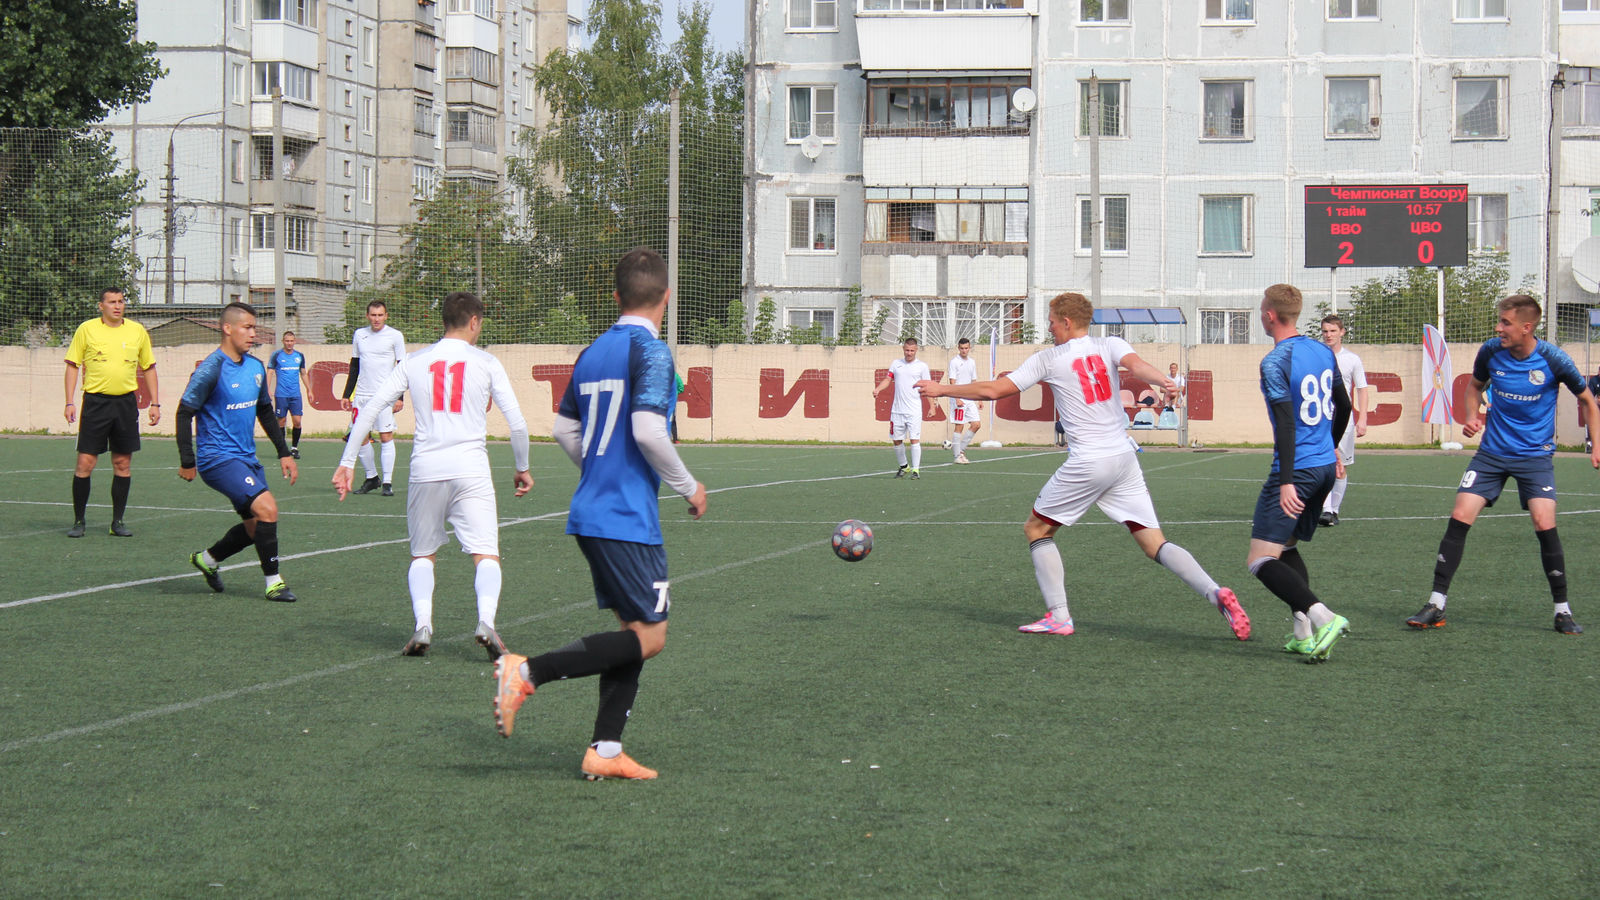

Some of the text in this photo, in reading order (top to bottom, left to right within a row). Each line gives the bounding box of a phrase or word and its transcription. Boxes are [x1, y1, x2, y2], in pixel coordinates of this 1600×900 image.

[1330, 186, 1467, 202] Чемпионат Воору
[1326, 205, 1366, 217] 1 тайм
[1406, 203, 1442, 216] 10:57
[1330, 223, 1362, 235] ВВО
[1410, 221, 1442, 235] ЦВО
[1337, 241, 1354, 264] 2
[1417, 240, 1434, 263] 0
[429, 360, 466, 413] 11
[1072, 354, 1112, 404] 13
[1300, 368, 1335, 426] 88
[579, 379, 625, 456] 77
[954, 408, 964, 421] 10
[244, 476, 254, 486] 9
